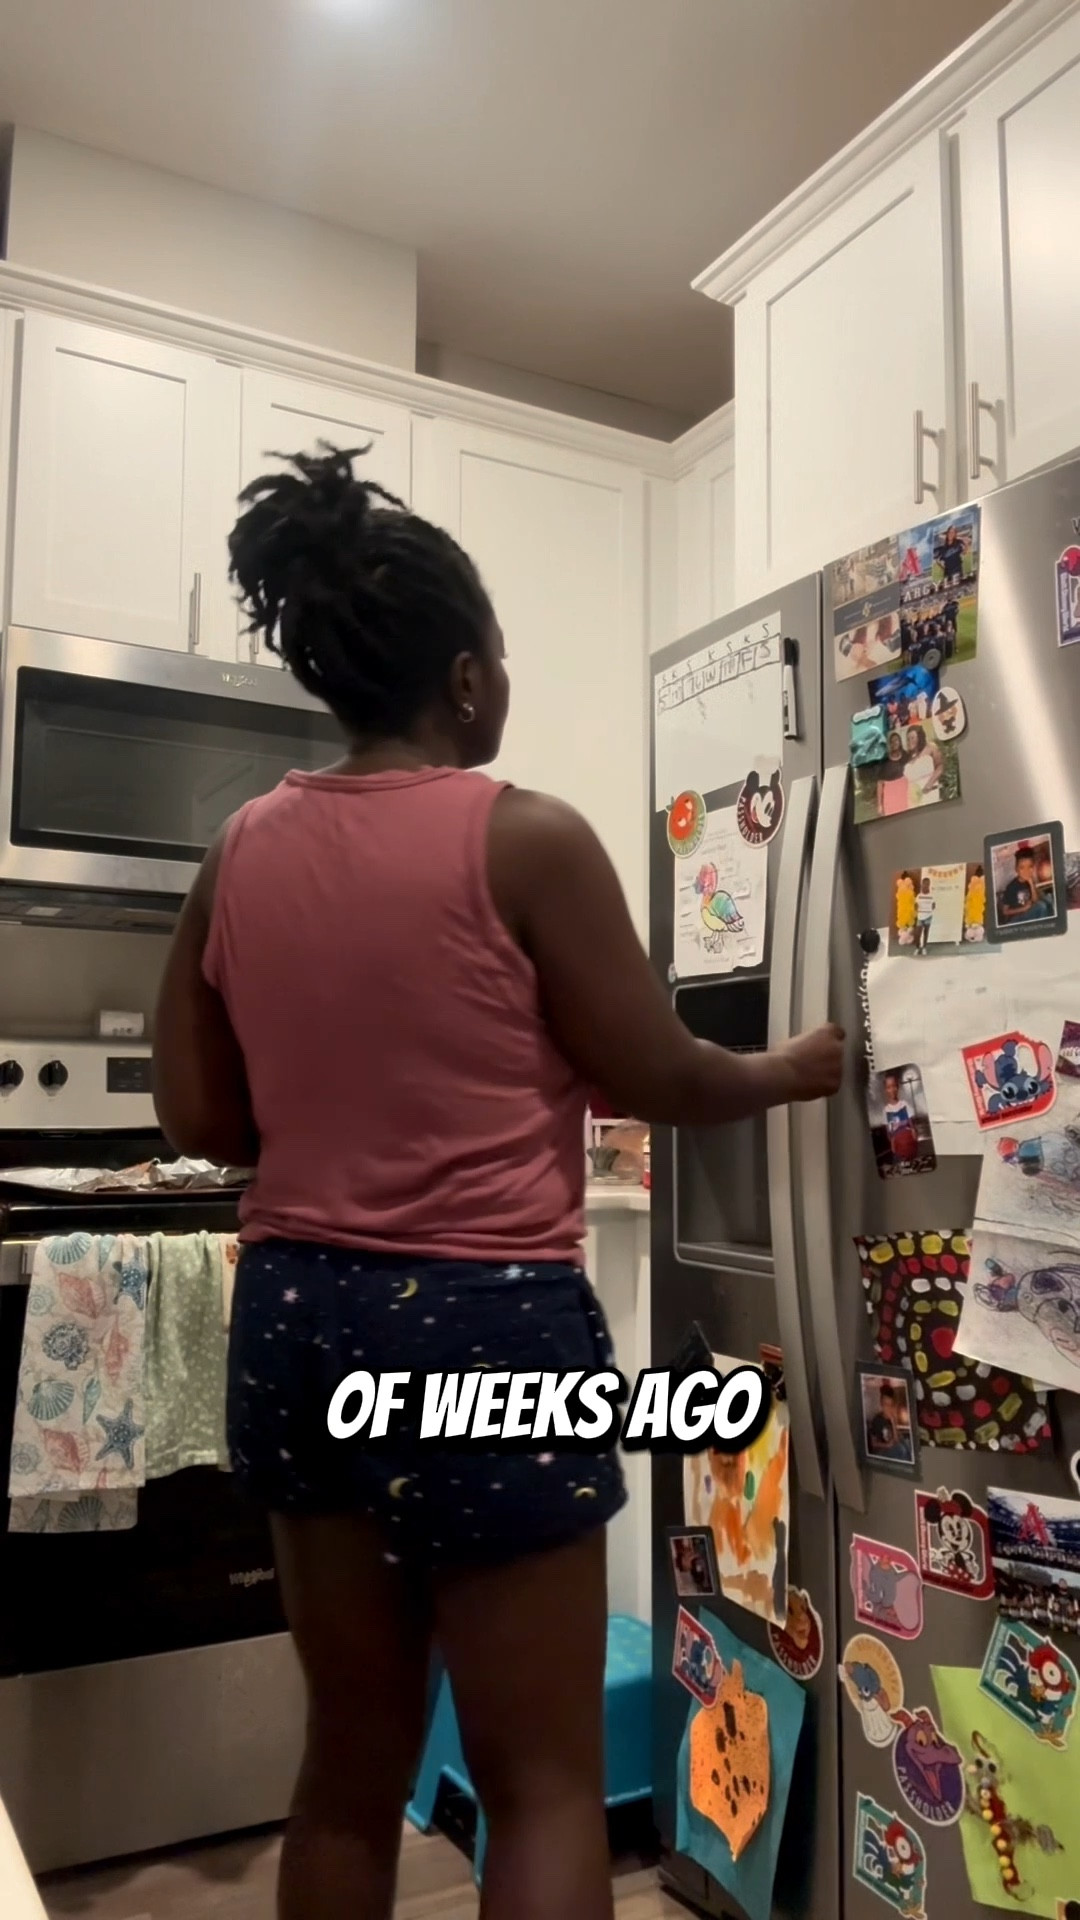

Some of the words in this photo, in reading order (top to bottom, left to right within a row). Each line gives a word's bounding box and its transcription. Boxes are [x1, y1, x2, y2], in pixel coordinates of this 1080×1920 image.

[903, 573, 960, 603] ARGYLE
[771, 1632, 816, 1676] PASSHOLDER
[897, 1766, 955, 1821] PASSHOLDER
